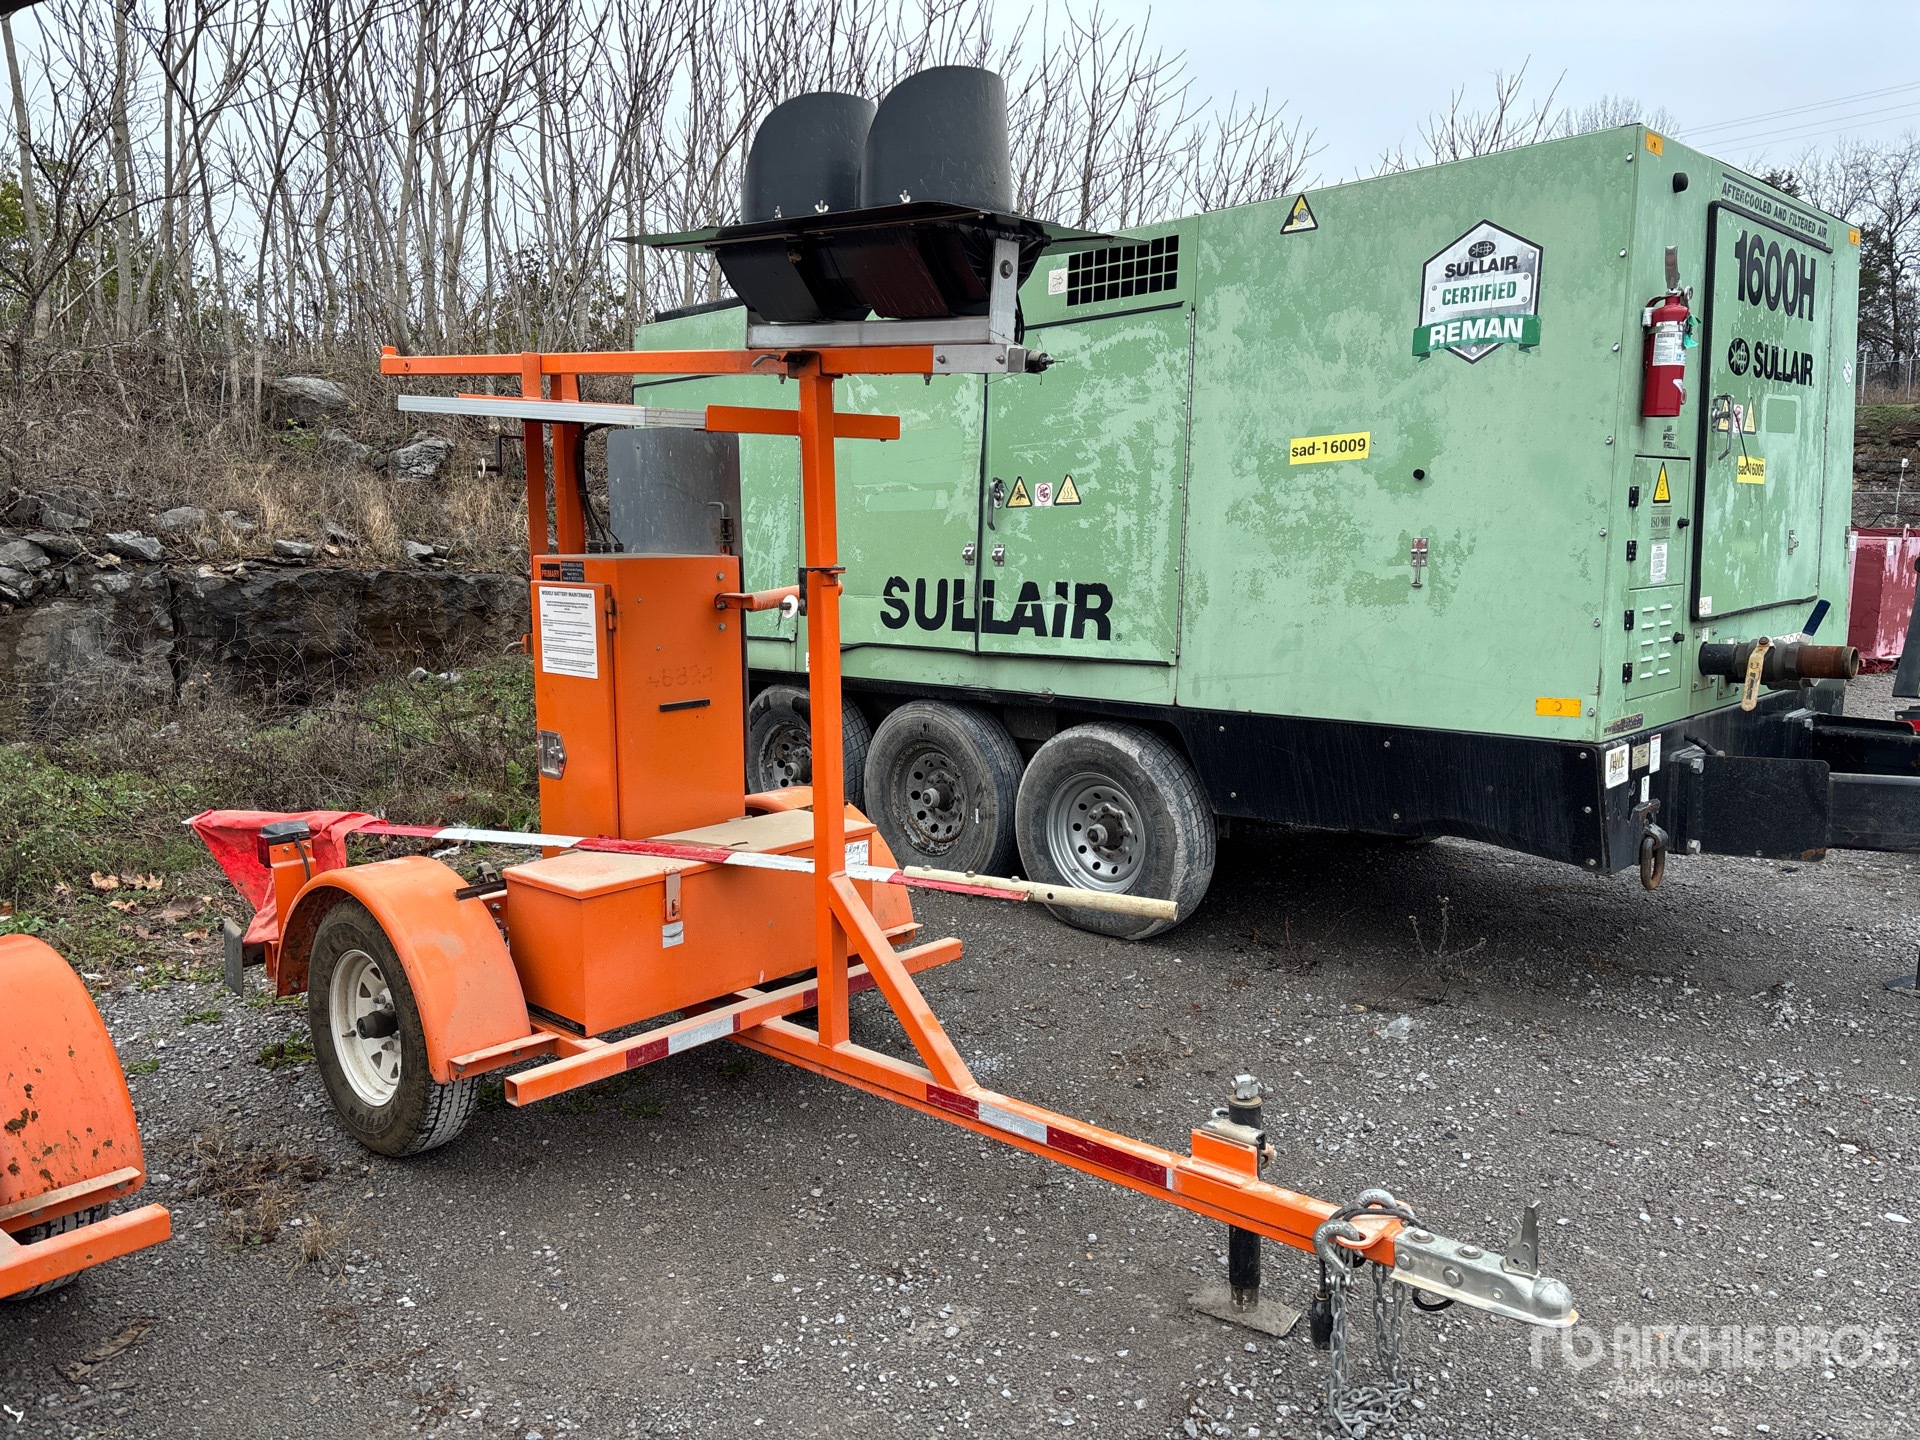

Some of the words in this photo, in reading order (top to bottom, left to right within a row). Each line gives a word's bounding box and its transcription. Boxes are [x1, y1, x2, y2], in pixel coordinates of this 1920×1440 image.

[1773, 208, 1787, 221] AND
[1788, 211, 1816, 234] FILTERED
[1817, 227, 1828, 240] AIR
[1445, 255, 1518, 278] SULLAIR
[1734, 229, 1817, 322] 1600H
[1441, 281, 1517, 306] CERTIFIED
[1429, 317, 1524, 347] REMAN
[1753, 341, 1814, 386] SULLAIR
[1291, 437, 1366, 457] sad-16009
[880, 576, 1113, 641] SULLAIR
